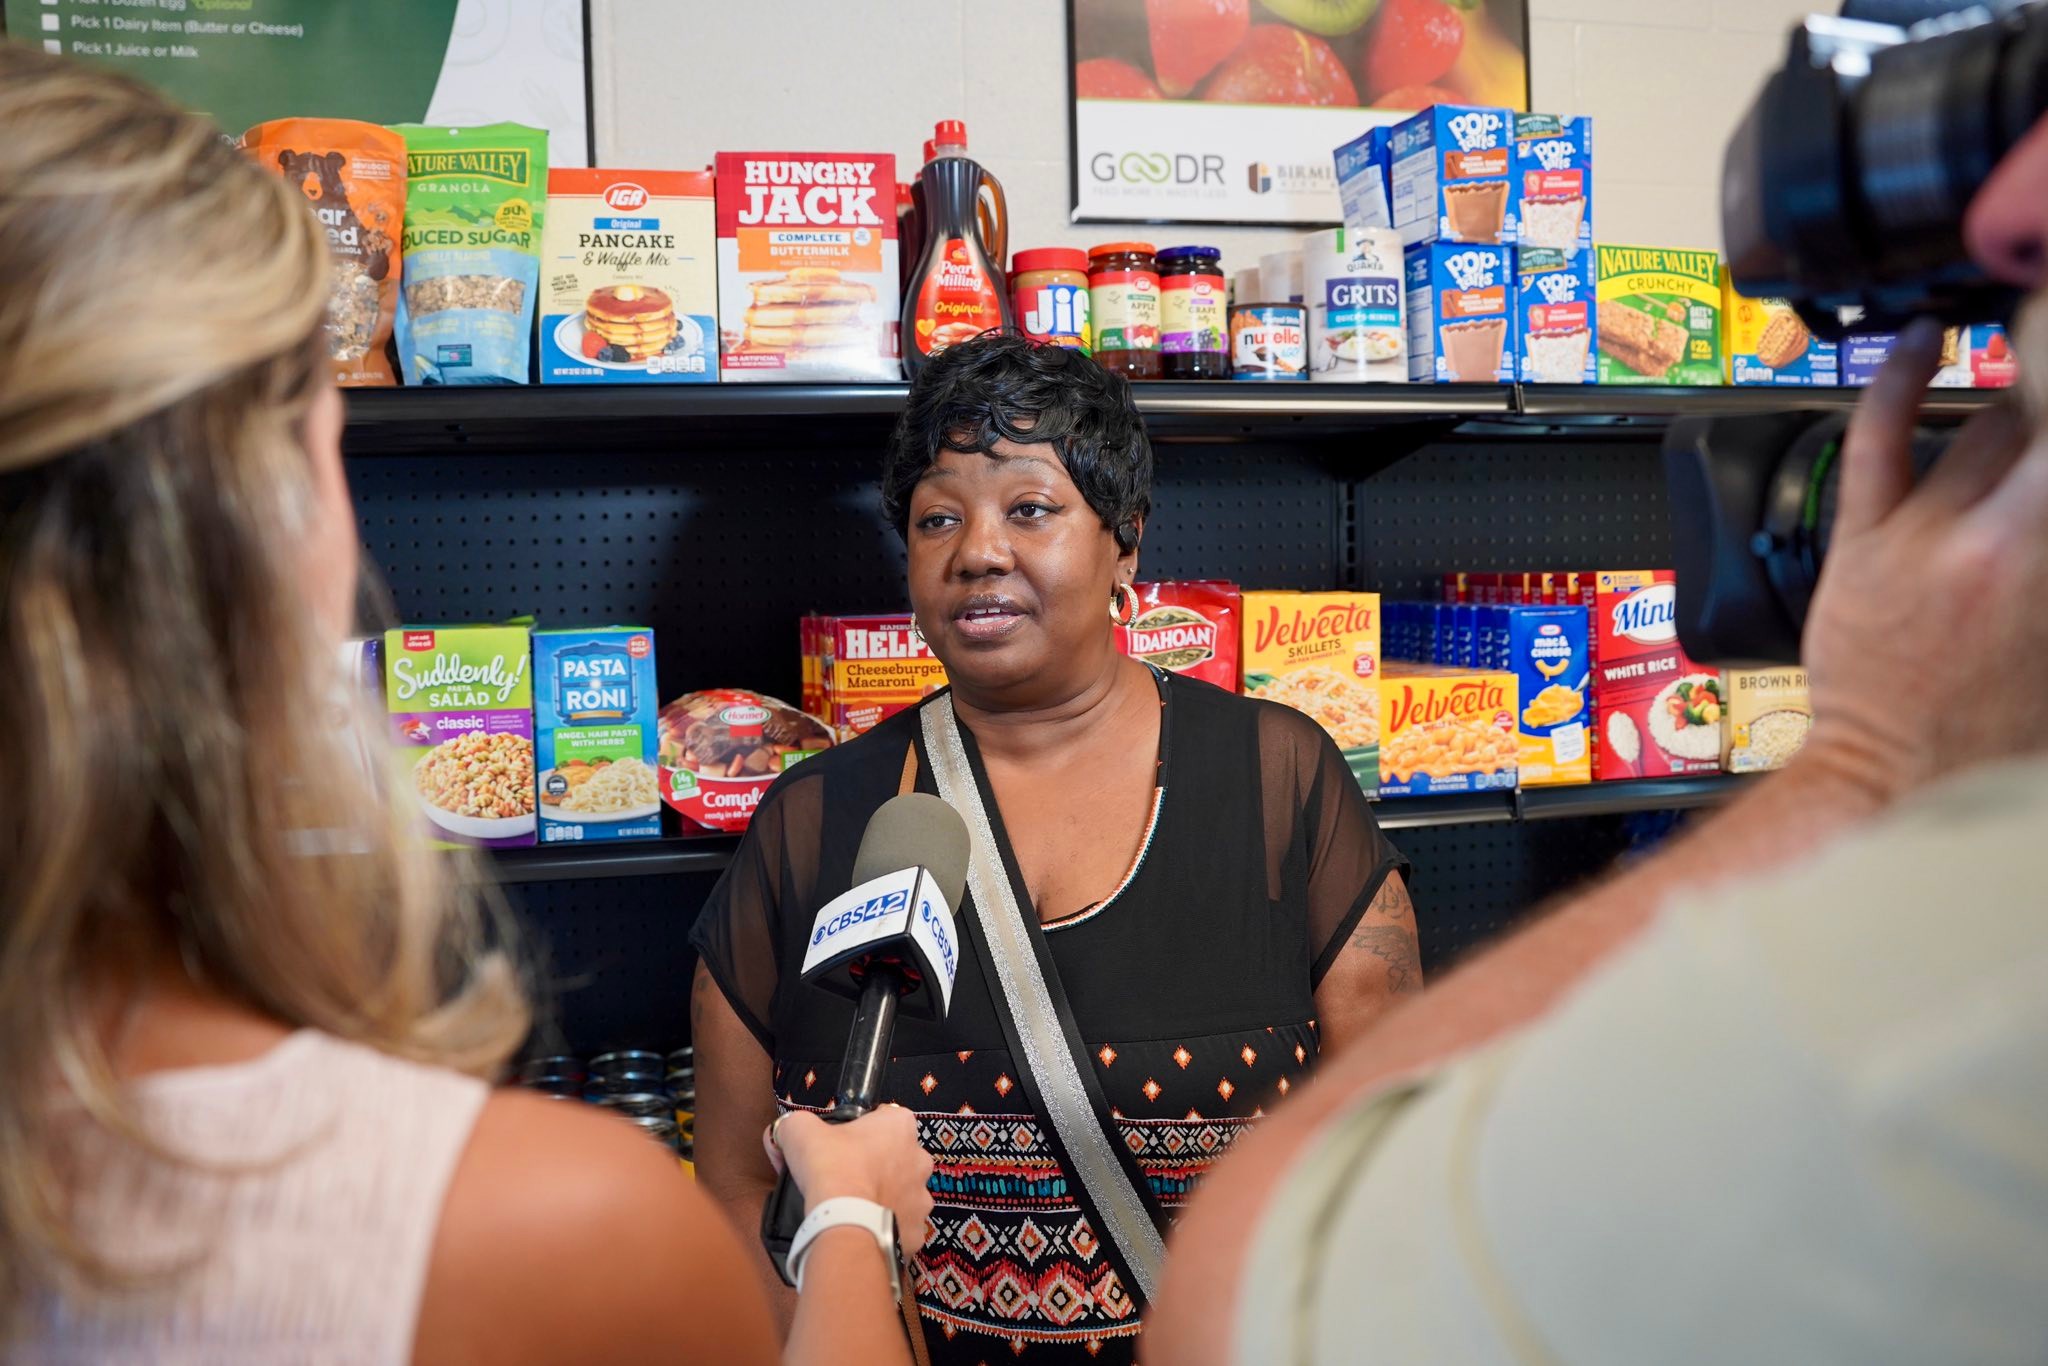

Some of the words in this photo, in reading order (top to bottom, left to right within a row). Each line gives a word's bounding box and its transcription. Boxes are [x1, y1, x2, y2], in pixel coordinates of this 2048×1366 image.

[71, 15, 101, 29] Pick
[104, 17, 110, 29] 1
[113, 18, 149, 33] Dairy
[152, 20, 182, 33] Item
[184, 22, 229, 37] (Butter
[232, 24, 246, 34] or
[249, 24, 304, 38] Cheese)
[73, 41, 102, 54] Pick
[105, 43, 112, 54] 1
[115, 44, 150, 57] Juice
[153, 46, 169, 57] or
[171, 46, 200, 58] Milk
[407, 155, 457, 176] ATURE
[460, 153, 523, 181] VALLEY
[744, 160, 876, 186] HUNGRY
[1091, 152, 1225, 185] GOODR
[1277, 164, 1335, 180] BIRMI
[417, 183, 490, 194] GRANOLA
[609, 189, 644, 206] IGA
[738, 185, 883, 225] JACK
[611, 219, 642, 230] Original
[402, 230, 464, 250] DUCED
[468, 229, 531, 249] SUGAR
[579, 233, 675, 249] PANCAKE
[777, 233, 842, 242] COMPLETE
[769, 246, 850, 257] BUTTERMILK
[583, 251, 594, 266] &
[597, 251, 642, 272] Waffle
[645, 252, 671, 266] Mix
[940, 260, 977, 276] Pearl
[1600, 248, 1662, 279] NATURE
[1662, 251, 1716, 284] VALLEY
[933, 273, 983, 292] Milling
[1627, 278, 1695, 293] CRUNCHY
[1331, 284, 1398, 307] GRITS
[934, 301, 984, 316] Original
[1024, 287, 1091, 336] Jif
[1244, 328, 1300, 345] nuella
[1615, 598, 1674, 633] Minu
[1254, 602, 1372, 653] Velveeta
[407, 640, 422, 648] olive
[422, 640, 432, 648] oil
[1132, 626, 1212, 653] IDAHOAN
[1288, 638, 1342, 658] SKILLETS
[563, 658, 627, 678] PASTA
[846, 663, 945, 677] Cheeseburger
[1604, 662, 1646, 681] WHITE
[1647, 656, 1677, 674] RICE
[393, 652, 527, 702] Suddenly!
[847, 675, 916, 689] Macaroni
[1739, 675, 1791, 691] BROWN
[447, 685, 472, 693] PASTA
[429, 691, 491, 708] SALAD
[566, 688, 627, 710] RONI
[1390, 680, 1505, 733] Velveeta
[436, 715, 484, 730] classic
[727, 710, 764, 721] Hormel
[557, 731, 587, 740] ANGEL
[588, 730, 609, 738] HAIR
[610, 728, 639, 738] PASTA
[571, 739, 596, 748] WITH
[596, 737, 625, 747] HERBS
[704, 810, 725, 821] ready
